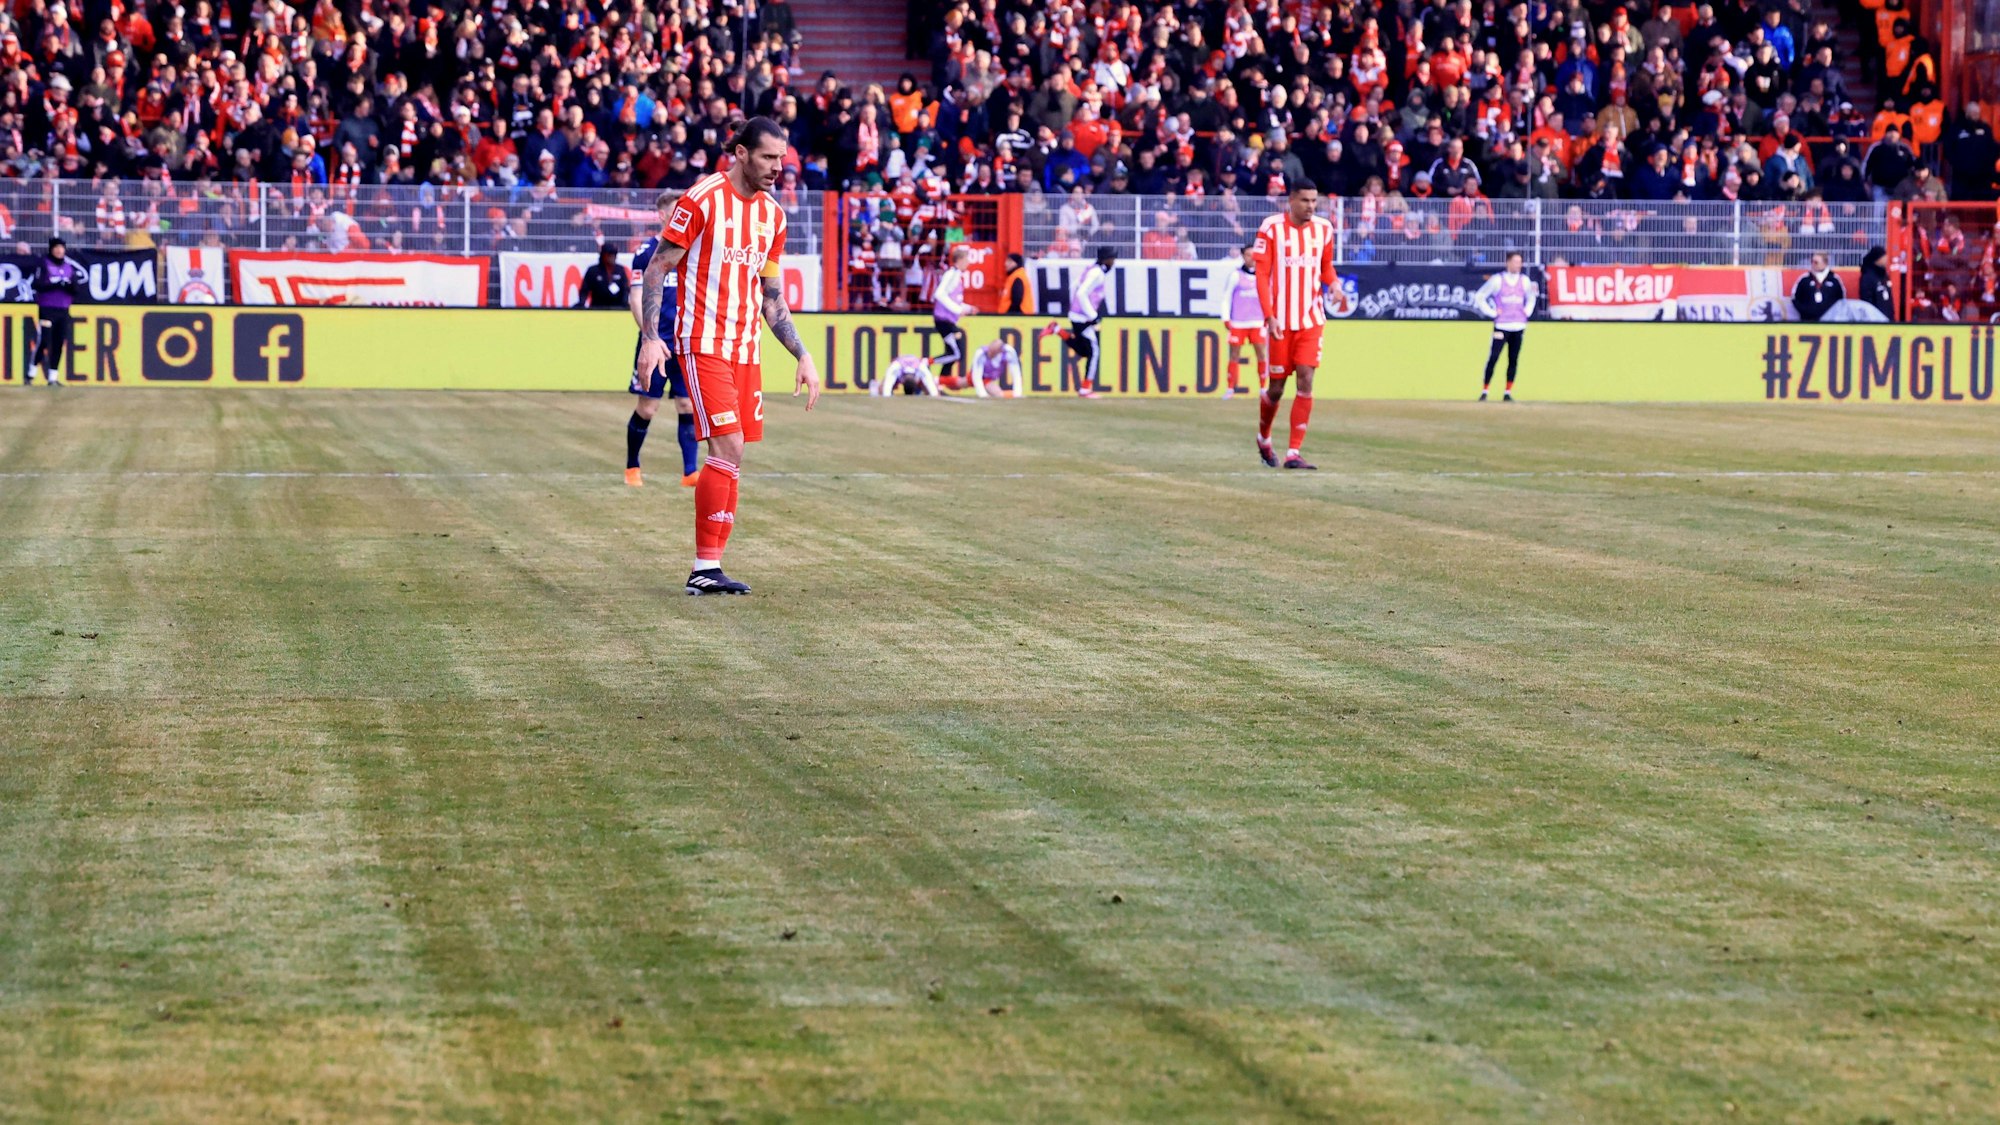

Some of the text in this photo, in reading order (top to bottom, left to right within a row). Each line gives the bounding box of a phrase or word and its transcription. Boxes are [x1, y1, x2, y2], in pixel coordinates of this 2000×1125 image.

[88, 260, 156, 301] UM
[961, 270, 984, 289] 10
[1037, 267, 1220, 316] HLLE
[1556, 268, 1674, 303] Luckau
[1762, 326, 1995, 400] #ZUMGLÜ
